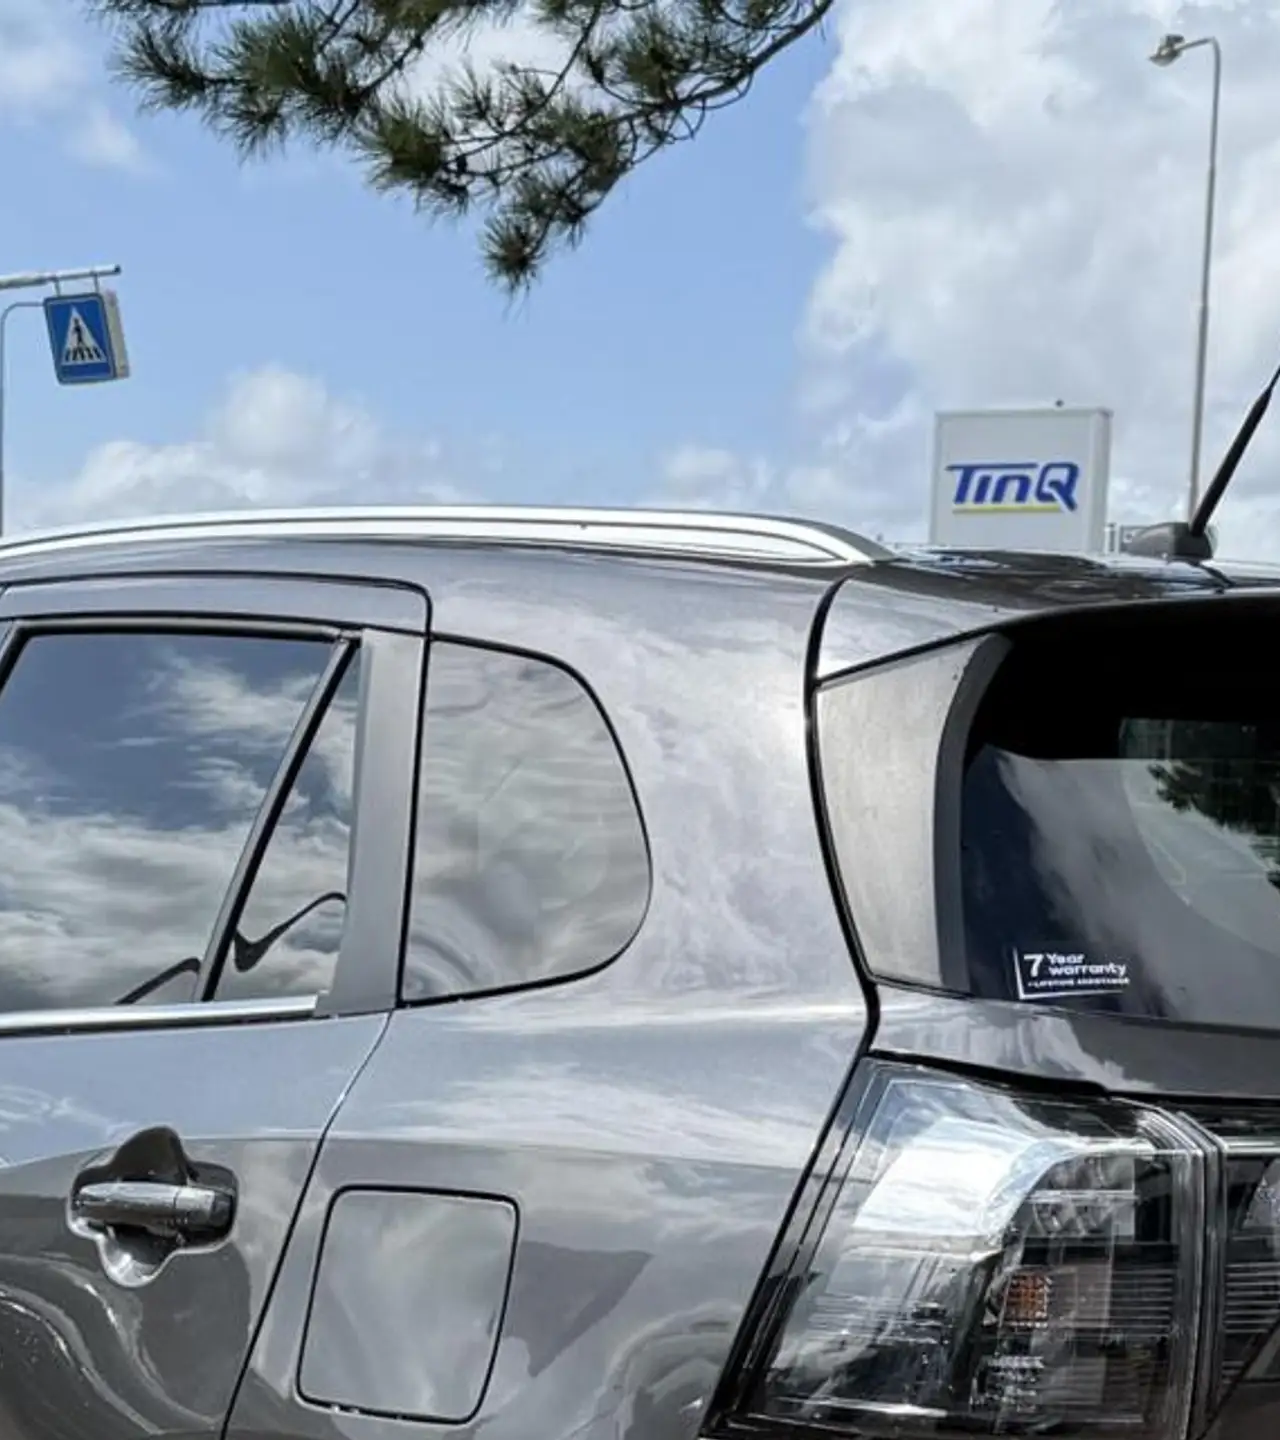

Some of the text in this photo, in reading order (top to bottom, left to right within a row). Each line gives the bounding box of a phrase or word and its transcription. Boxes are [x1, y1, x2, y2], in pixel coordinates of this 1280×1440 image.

[1024, 953, 1084, 977] 7 Year
[1048, 962, 1127, 978] warranty
